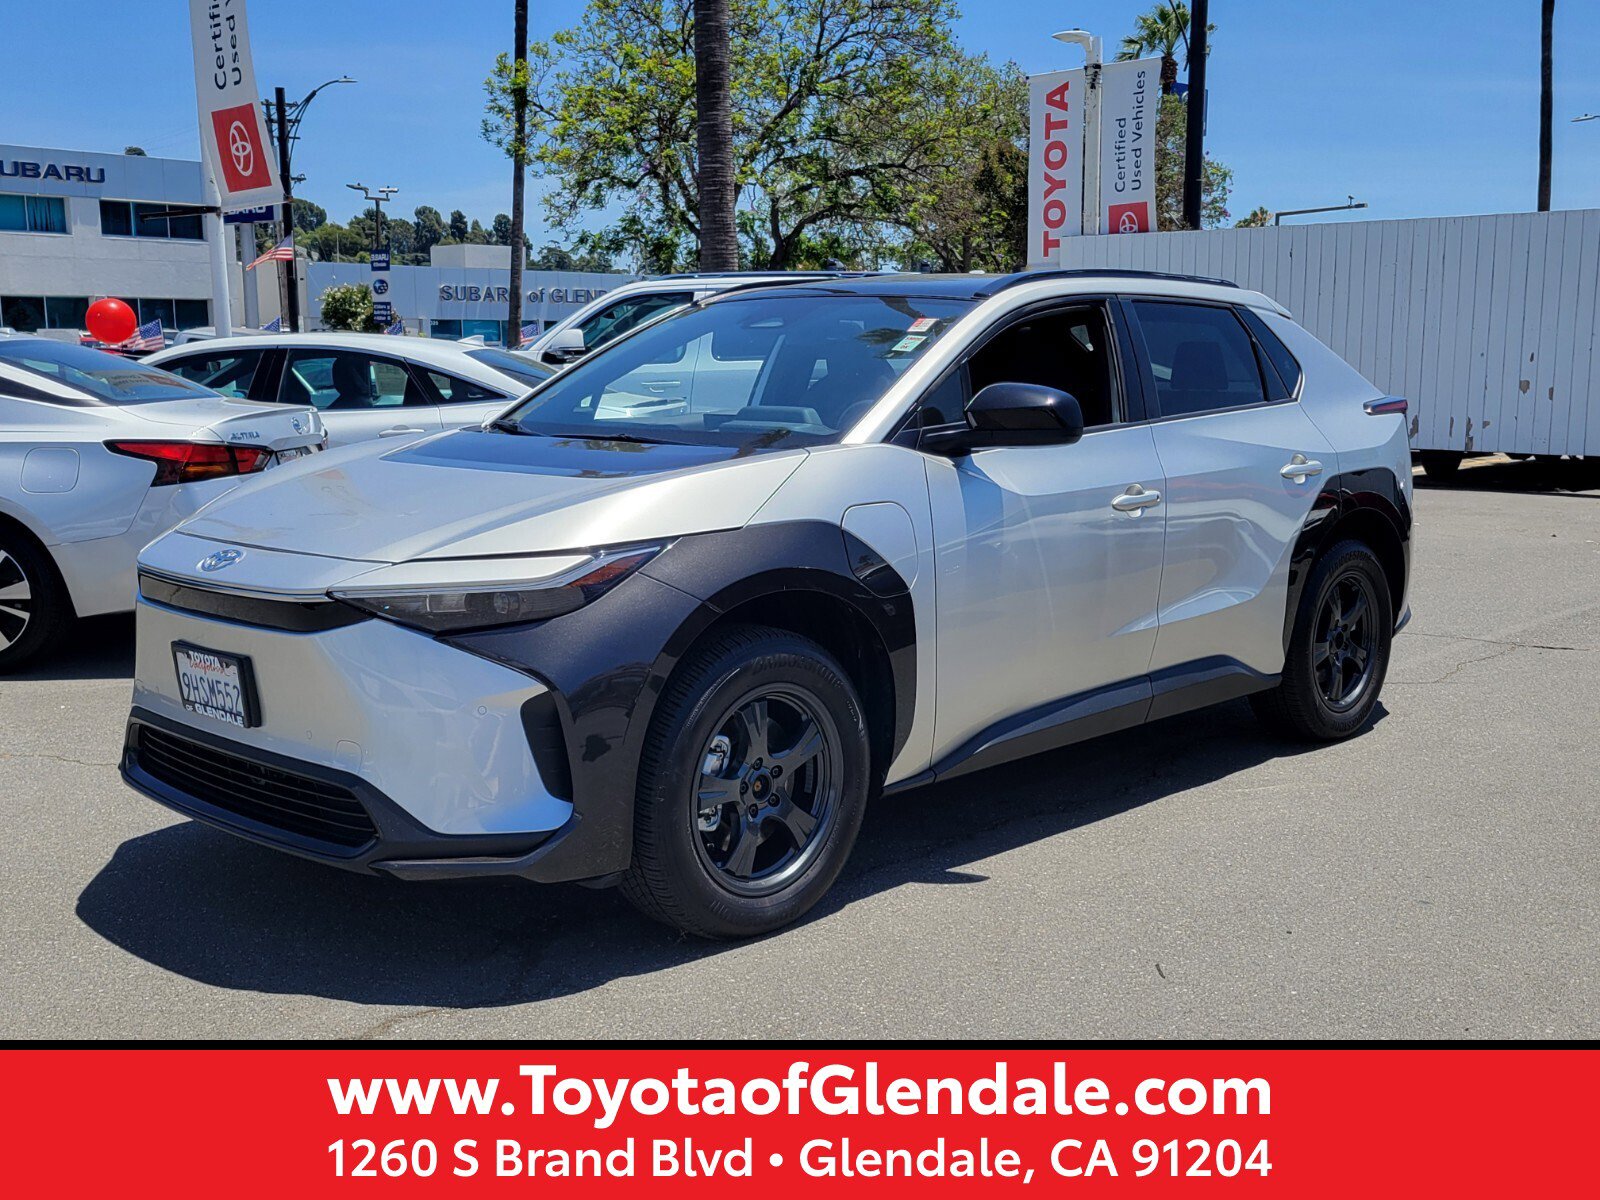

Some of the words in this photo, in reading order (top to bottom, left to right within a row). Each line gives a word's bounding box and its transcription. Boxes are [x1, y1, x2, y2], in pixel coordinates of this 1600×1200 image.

[209, 0, 227, 90] Certifi
[225, 14, 242, 86] Used
[1131, 70, 1146, 141] Vehicles
[1043, 81, 1070, 258] TOYOTA
[1114, 117, 1127, 193] Certified
[1131, 148, 1142, 191] Used
[440, 285, 510, 302] SUBAR
[529, 288, 546, 303] of
[188, 650, 222, 667] TOYOTA
[181, 672, 243, 716] 9HSM552
[195, 703, 245, 728] GLENDALE
